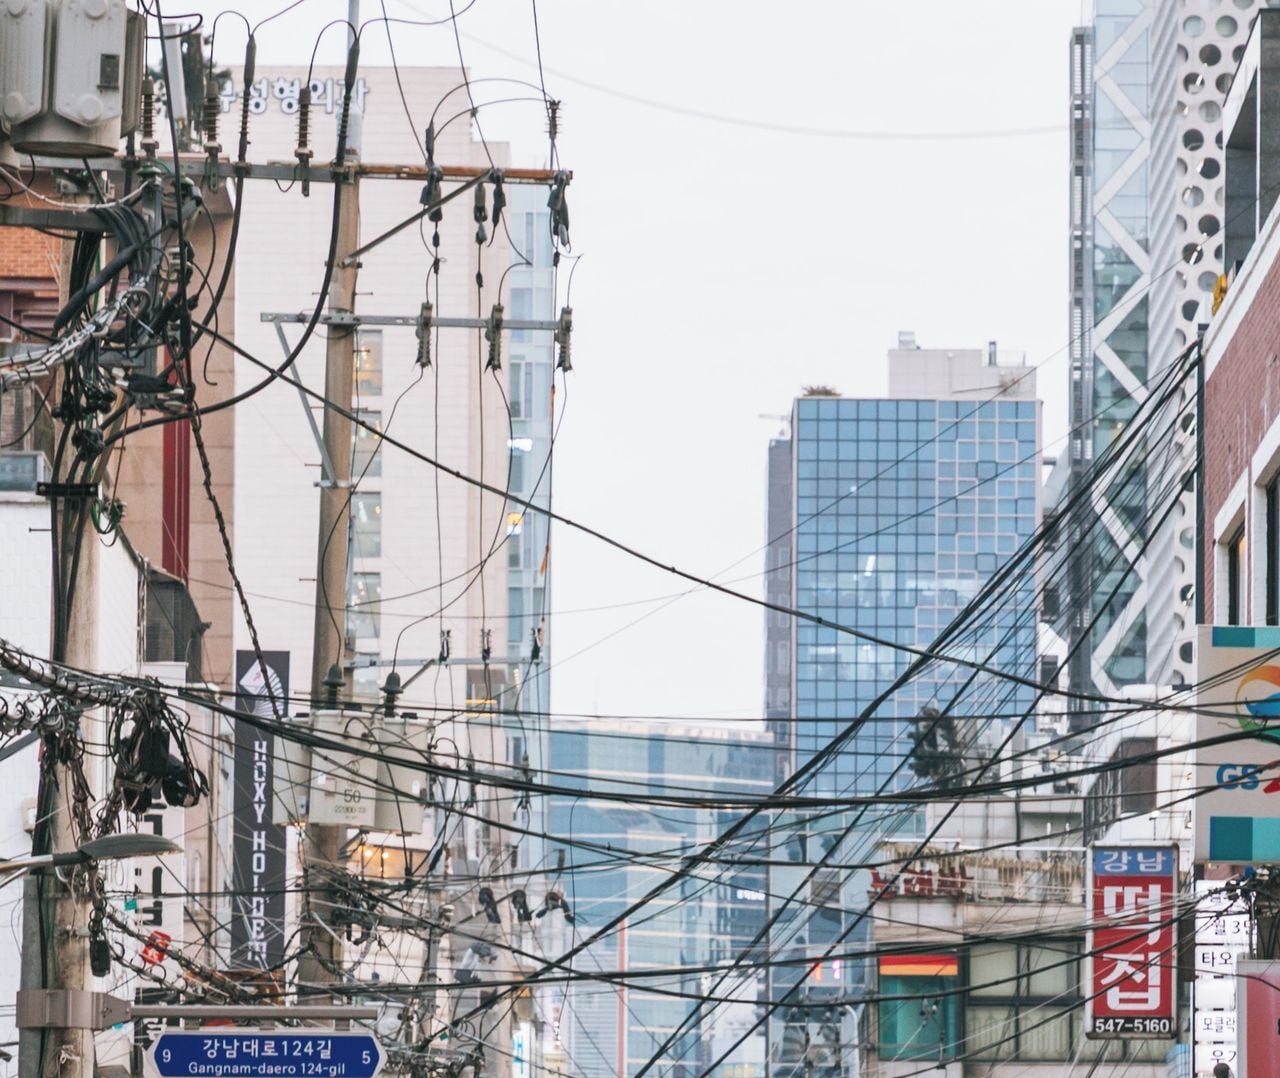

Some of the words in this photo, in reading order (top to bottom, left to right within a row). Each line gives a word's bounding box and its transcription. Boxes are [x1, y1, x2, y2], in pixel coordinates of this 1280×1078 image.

[343, 789, 361, 803] 50
[1101, 852, 1167, 872] 강남
[1101, 885, 1162, 1011] 떡집
[1096, 1017, 1169, 1034] 547-5160
[162, 1050, 172, 1063] 9
[203, 1039, 333, 1059] 강남대로124길
[362, 1051, 371, 1065] 5
[188, 1061, 296, 1076] Gangnam-daero
[301, 1062, 346, 1077] 124-gil
